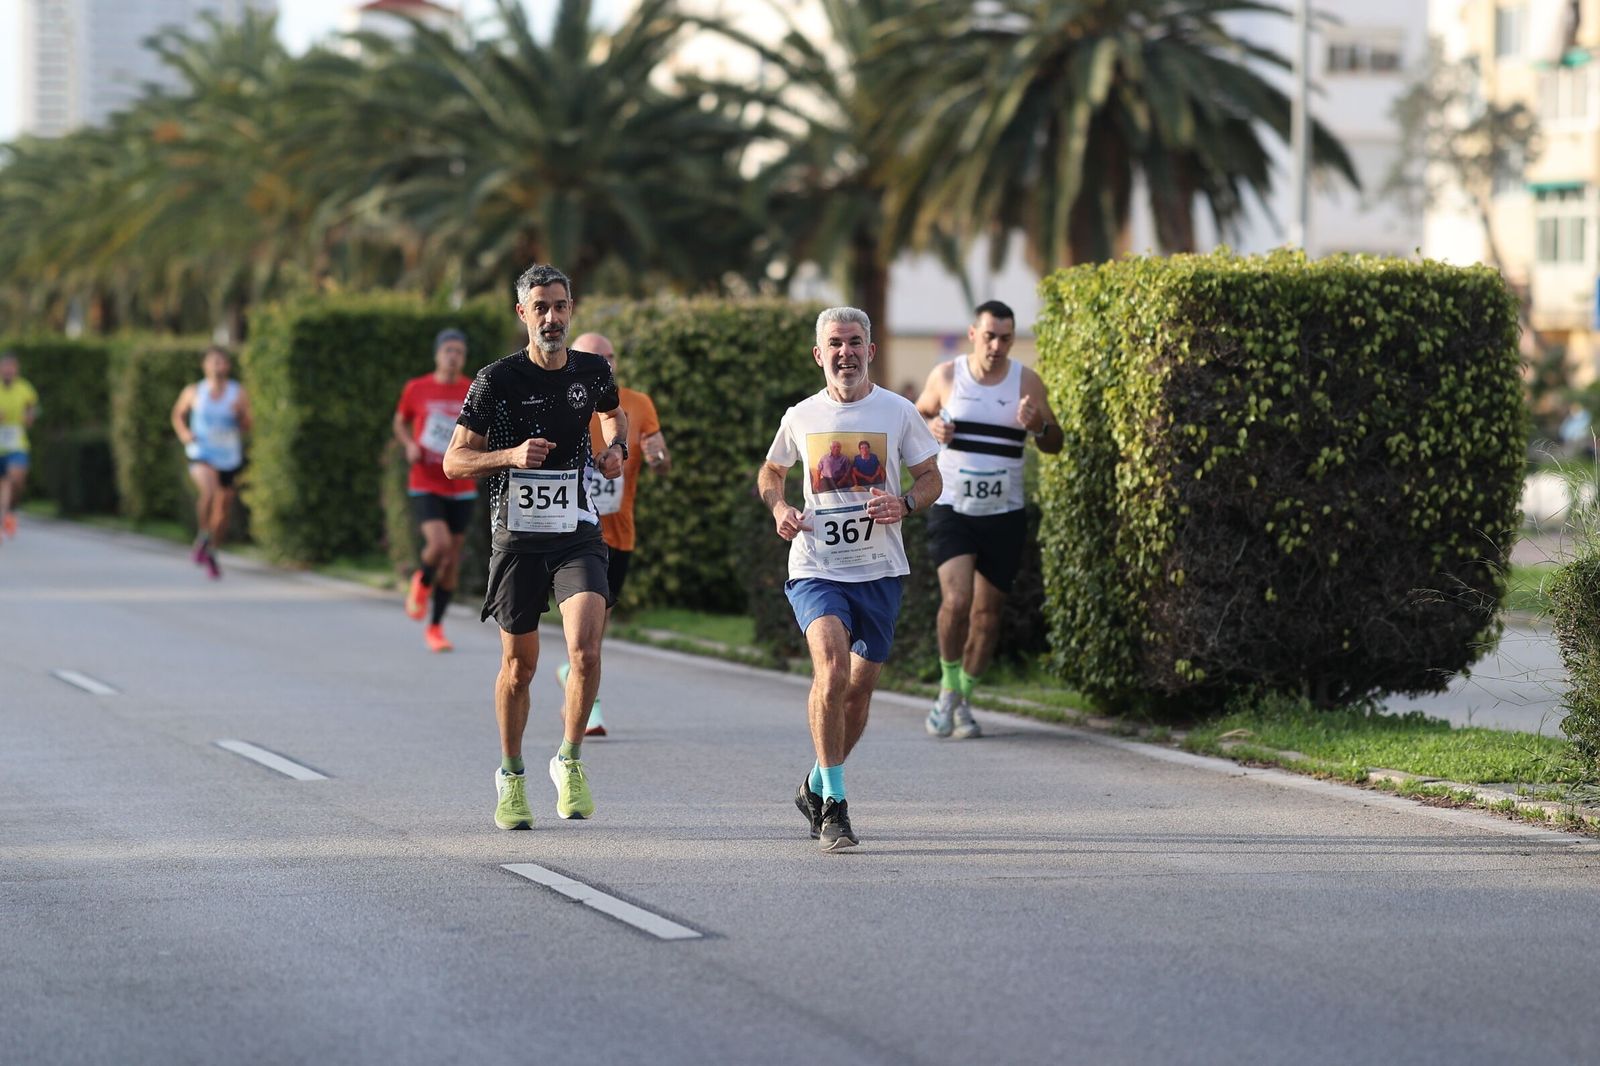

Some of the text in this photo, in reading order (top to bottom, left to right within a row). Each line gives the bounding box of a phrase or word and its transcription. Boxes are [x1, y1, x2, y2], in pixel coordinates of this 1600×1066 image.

[519, 485, 569, 509] 354
[963, 480, 1003, 499] 184
[825, 517, 874, 545] 367
